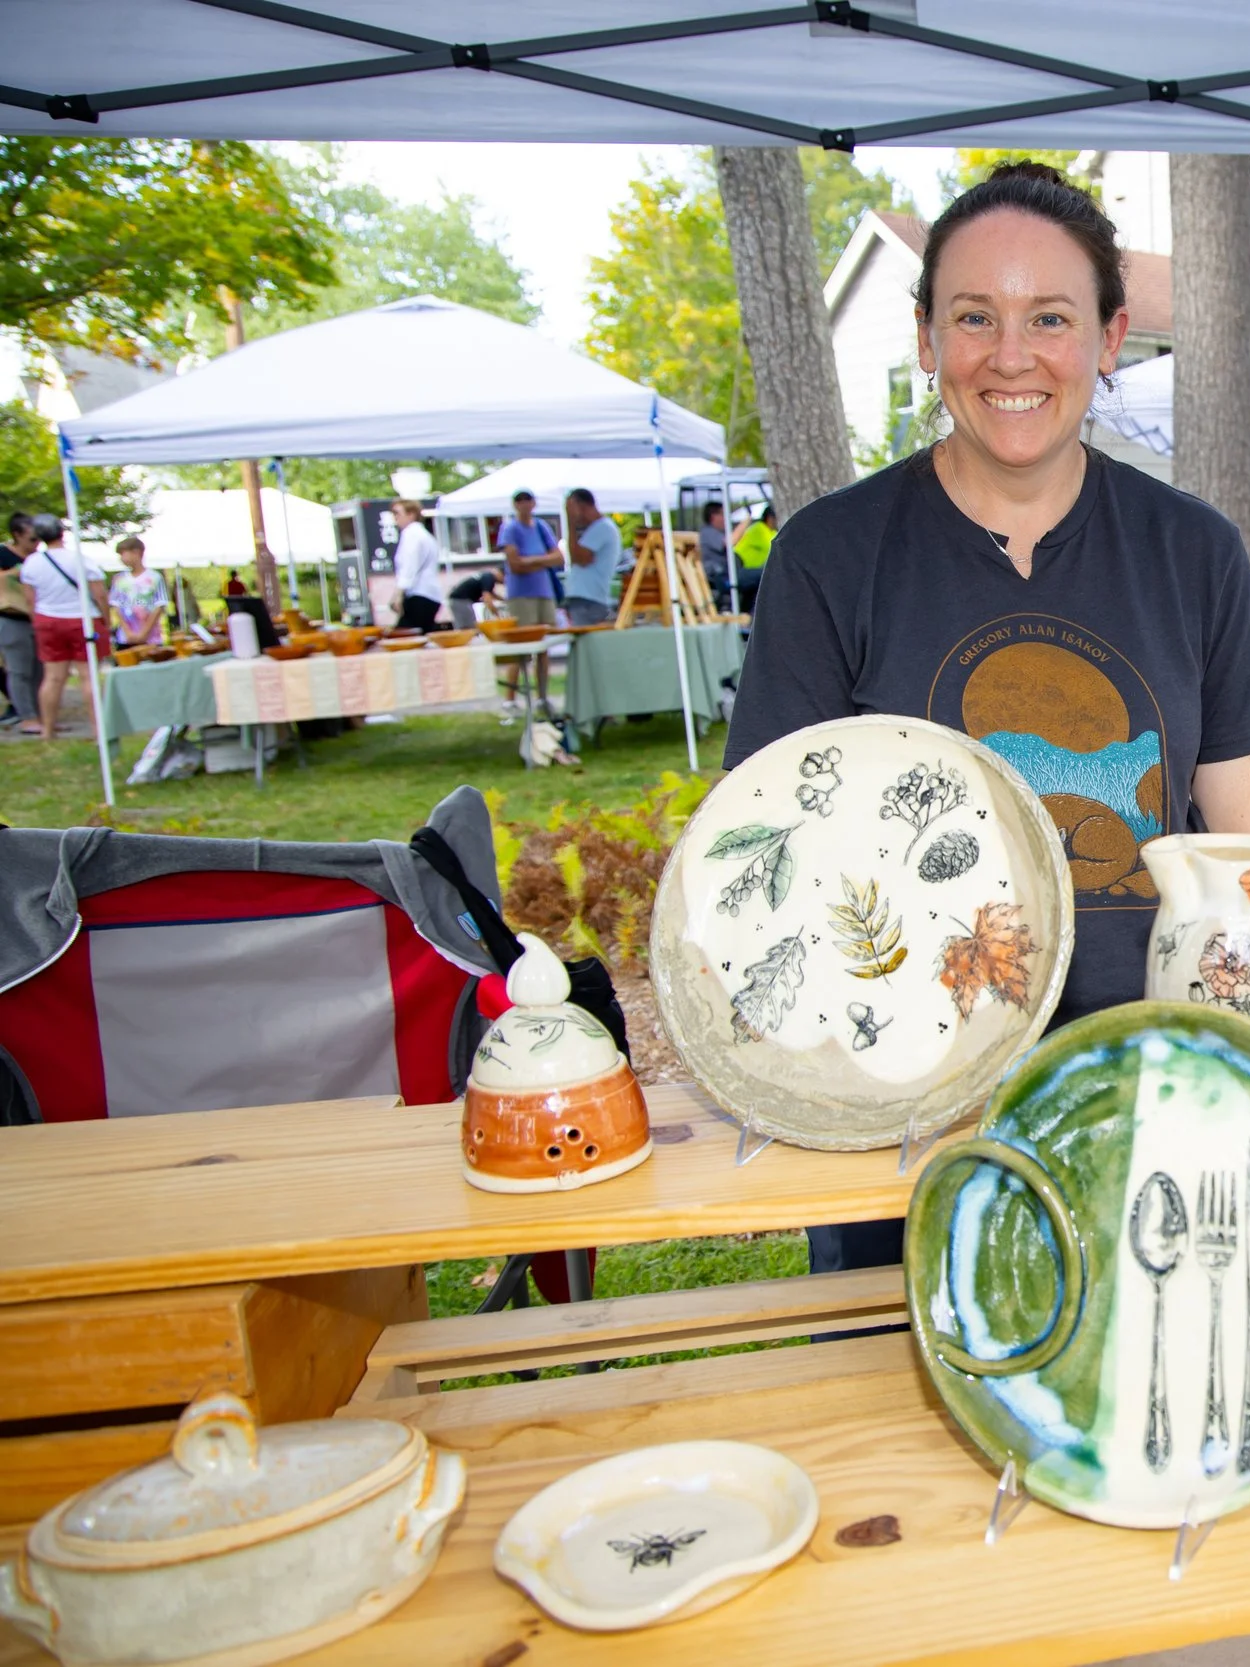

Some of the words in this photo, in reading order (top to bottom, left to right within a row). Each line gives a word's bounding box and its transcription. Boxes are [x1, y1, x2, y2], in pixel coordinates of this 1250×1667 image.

[959, 627, 1012, 665] GREGORY
[1019, 623, 1055, 638] ALAN
[1061, 631, 1111, 663] ISAKOV
